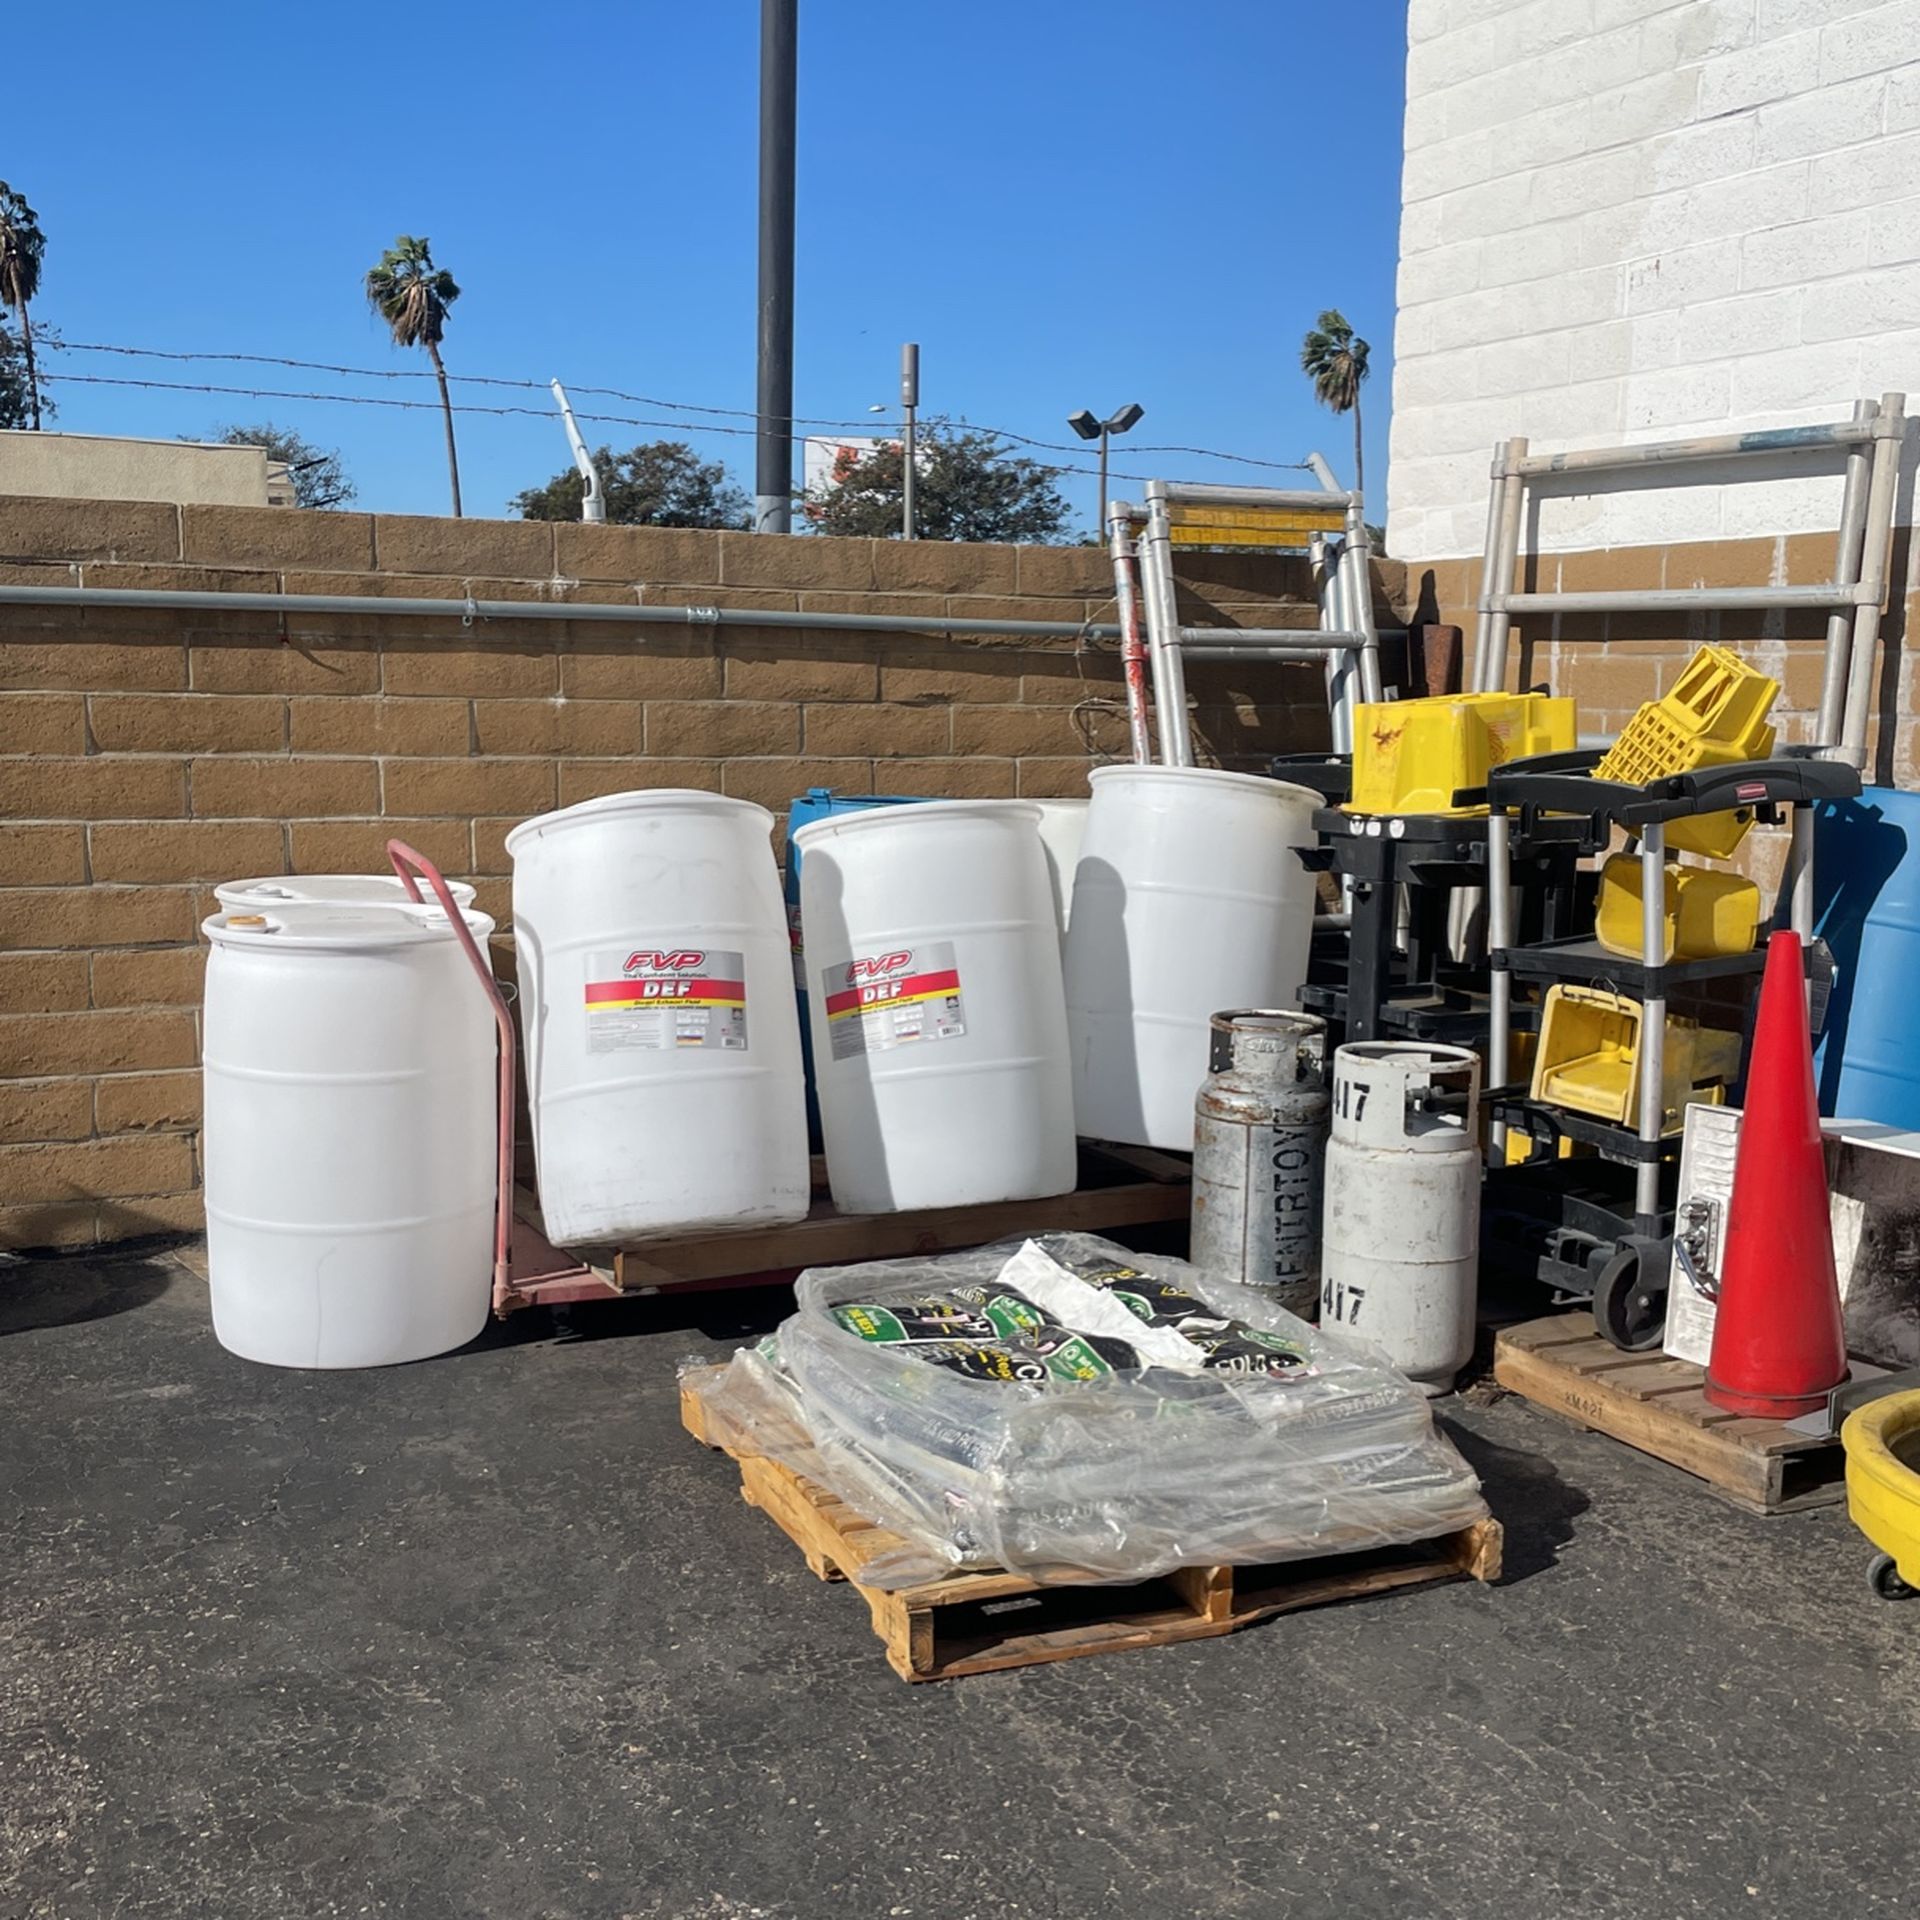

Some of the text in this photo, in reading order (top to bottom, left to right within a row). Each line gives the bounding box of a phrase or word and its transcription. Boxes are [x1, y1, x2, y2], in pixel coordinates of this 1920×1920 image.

[623, 950, 705, 972] FVP
[846, 950, 912, 982] FVP
[643, 980, 692, 998] DEF
[863, 981, 904, 1003] DEF
[1323, 1277, 1365, 1325] 417
